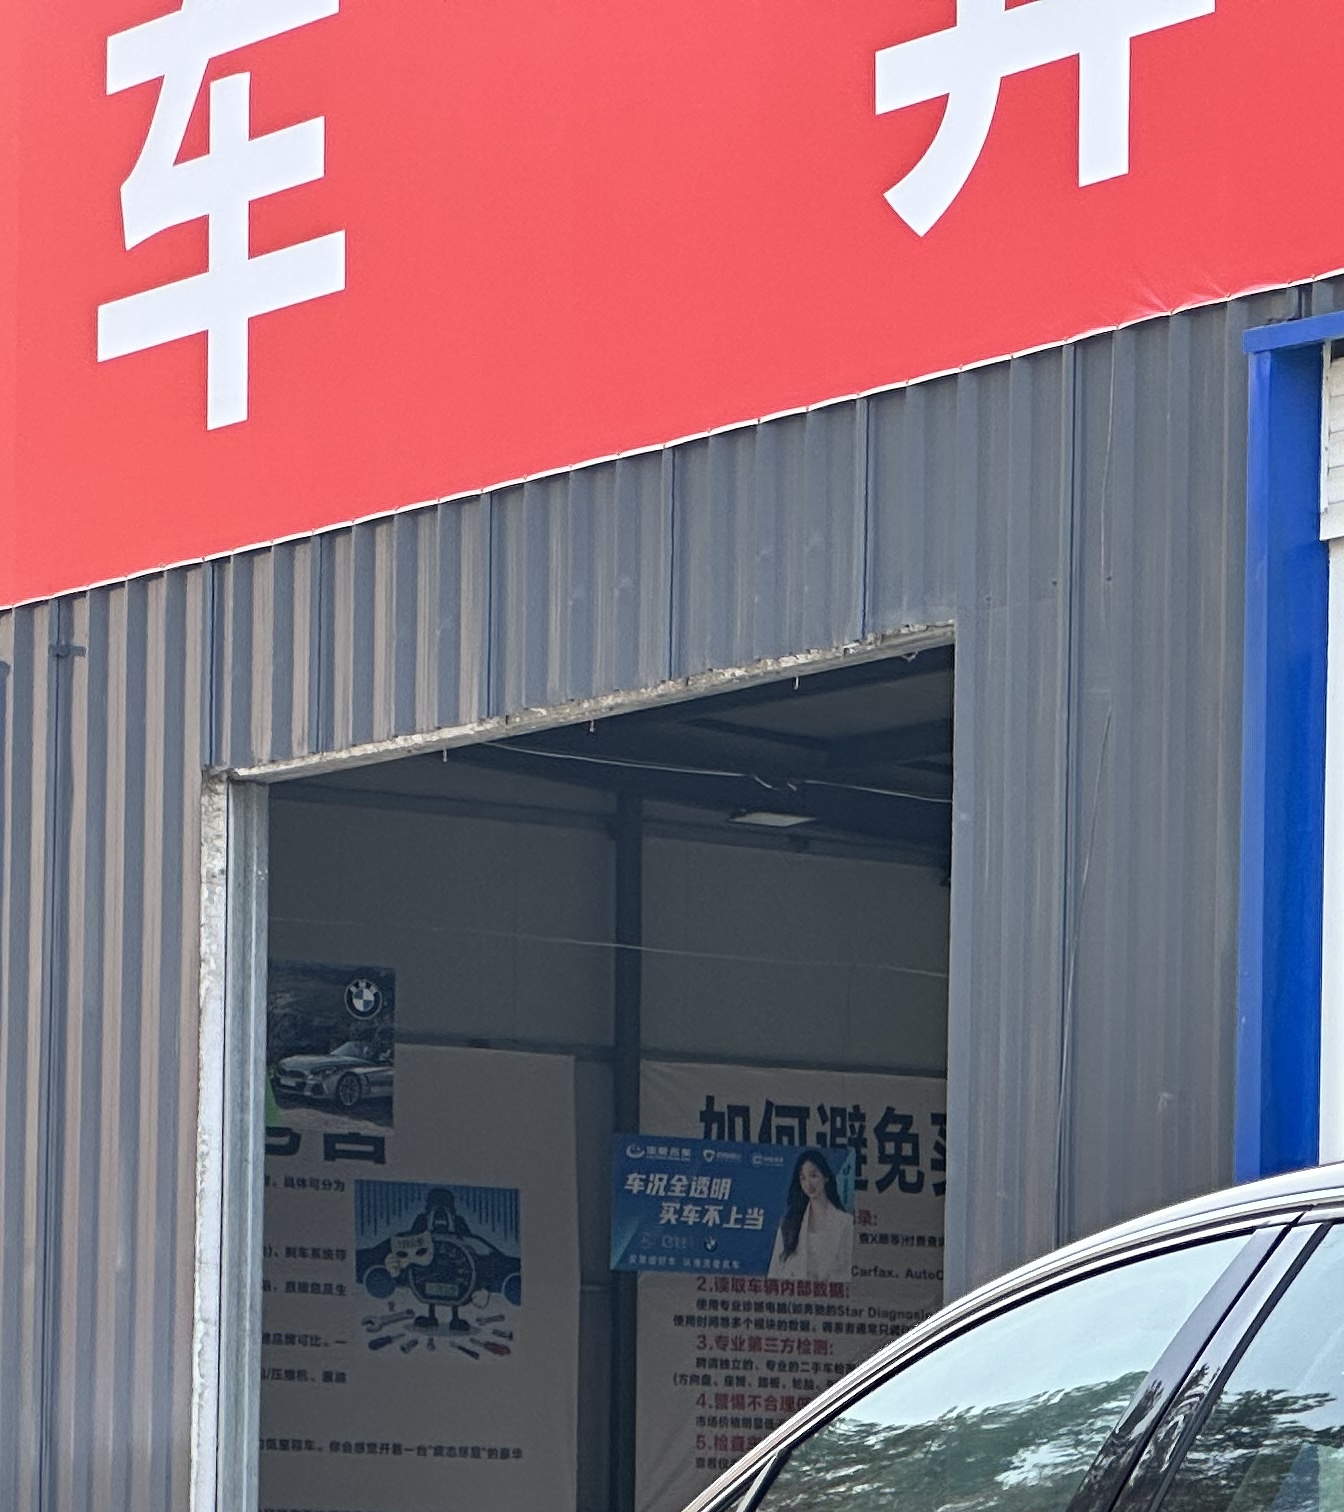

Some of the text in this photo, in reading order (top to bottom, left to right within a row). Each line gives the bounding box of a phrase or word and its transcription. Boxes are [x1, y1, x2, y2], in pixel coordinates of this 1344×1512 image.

[624, 1173, 732, 1200] 车况全透明
[659, 1203, 765, 1230] 买车不上当
